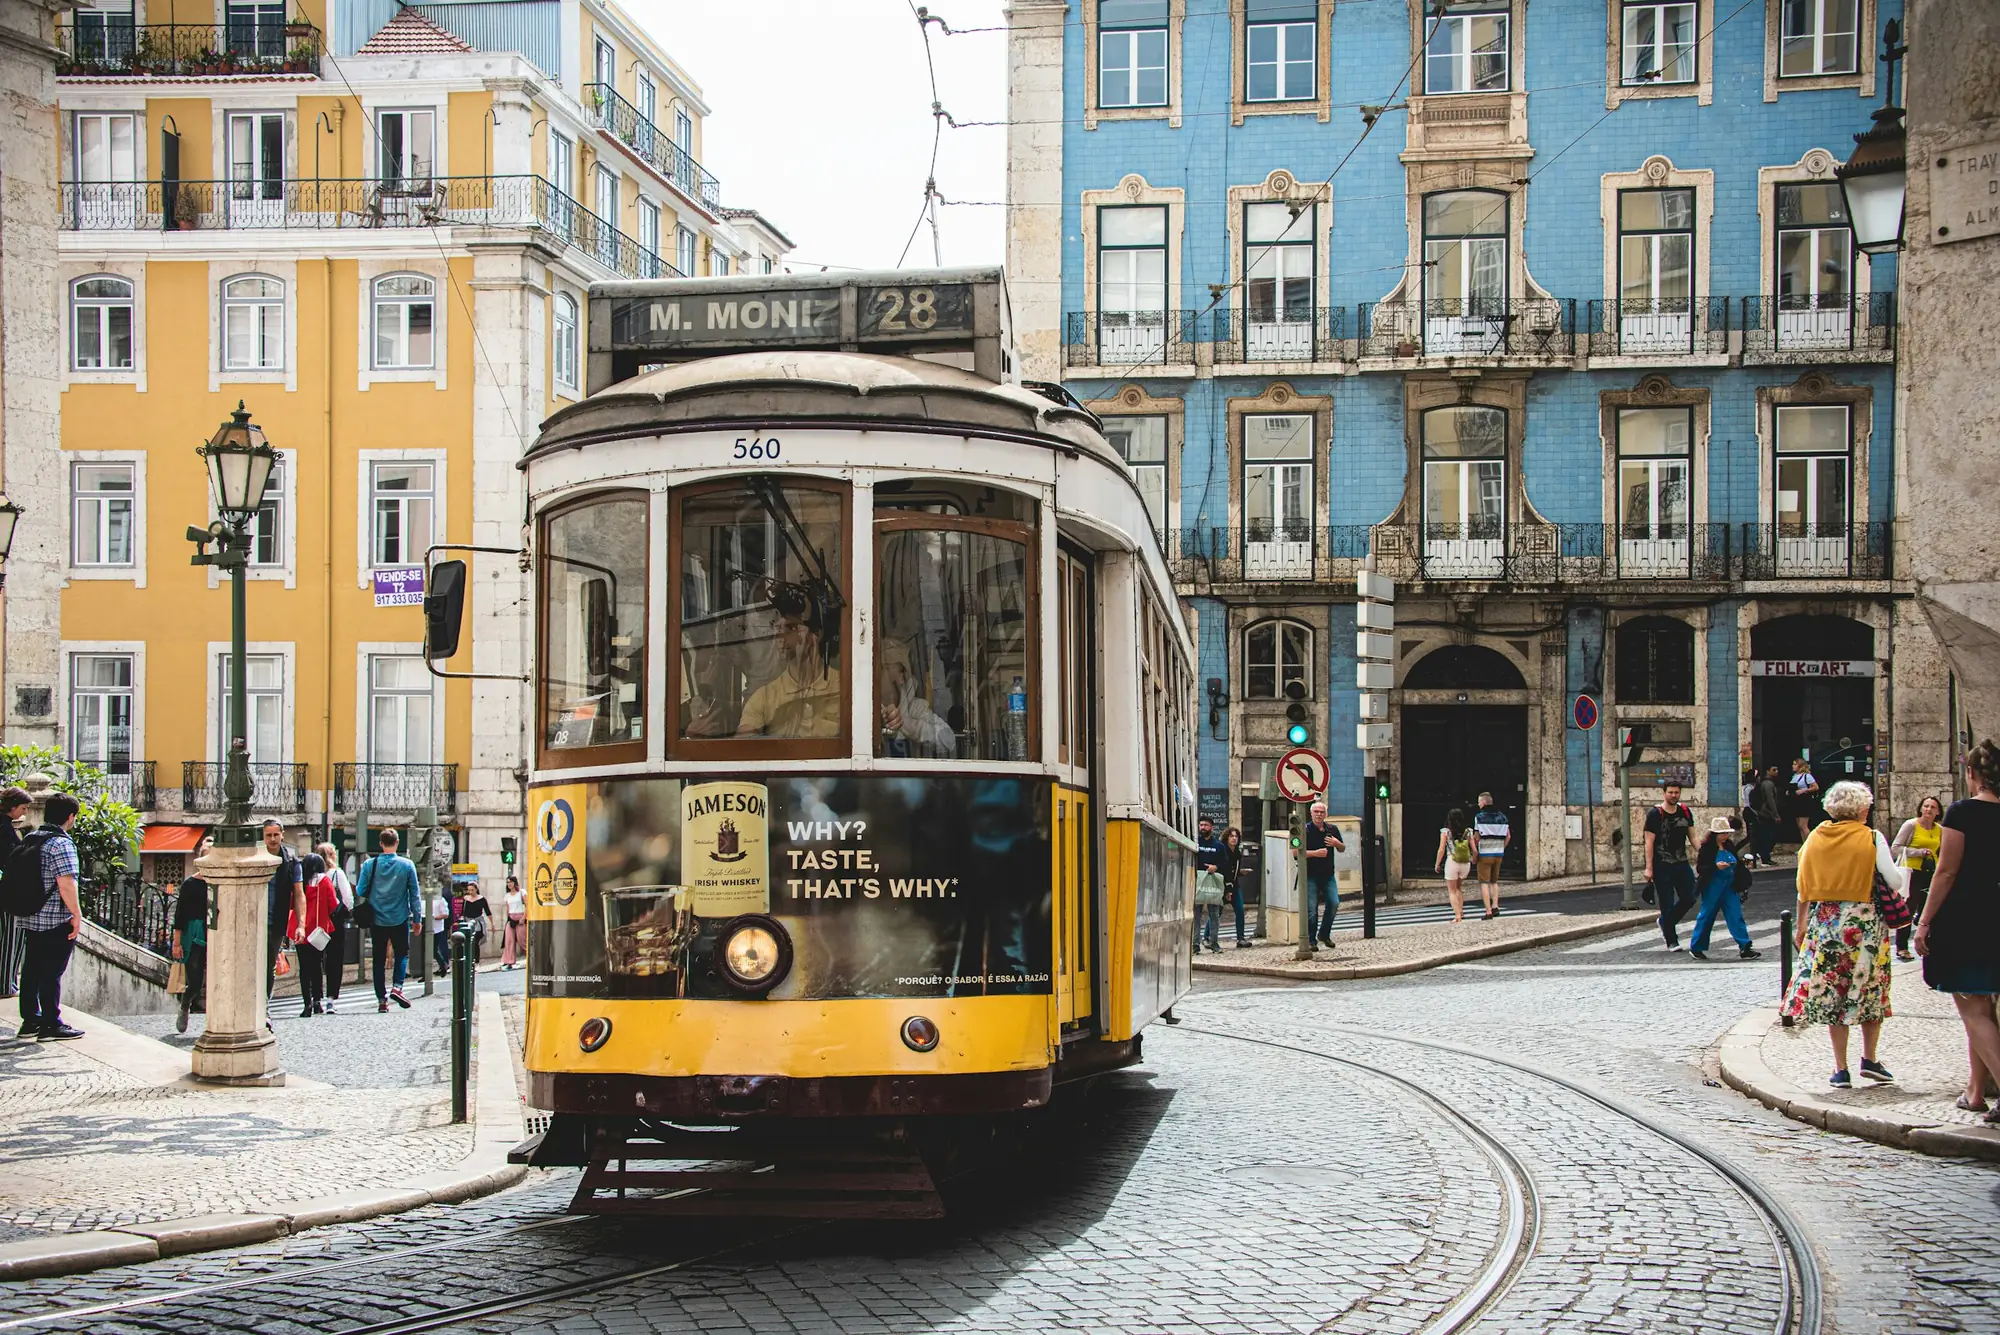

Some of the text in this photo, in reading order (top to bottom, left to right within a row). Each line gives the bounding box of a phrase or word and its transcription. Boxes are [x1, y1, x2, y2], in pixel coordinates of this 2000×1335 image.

[1957, 153, 1998, 175] TRAV
[650, 303, 692, 331] M.
[877, 287, 937, 330] 28
[733, 437, 781, 459] 560
[375, 570, 421, 582] VENDE-SE
[392, 582, 405, 593] T2
[376, 593, 423, 605] 917 333 035
[1765, 661, 1806, 675] FOLK
[1820, 661, 1850, 675] ART
[554, 730, 569, 744] 08
[688, 793, 767, 821] JAMESON
[787, 820, 867, 841] WHY?
[787, 850, 880, 872] TASTE,
[694, 877, 761, 887] IRISH WHISKEY
[787, 878, 881, 899] THAT'S
[945, 976, 952, 984] O
[988, 973, 994, 983] É
[995, 974, 1016, 983] ESSA
[1017, 974, 1024, 983] A
[1024, 972, 1049, 982] RAZÃO
